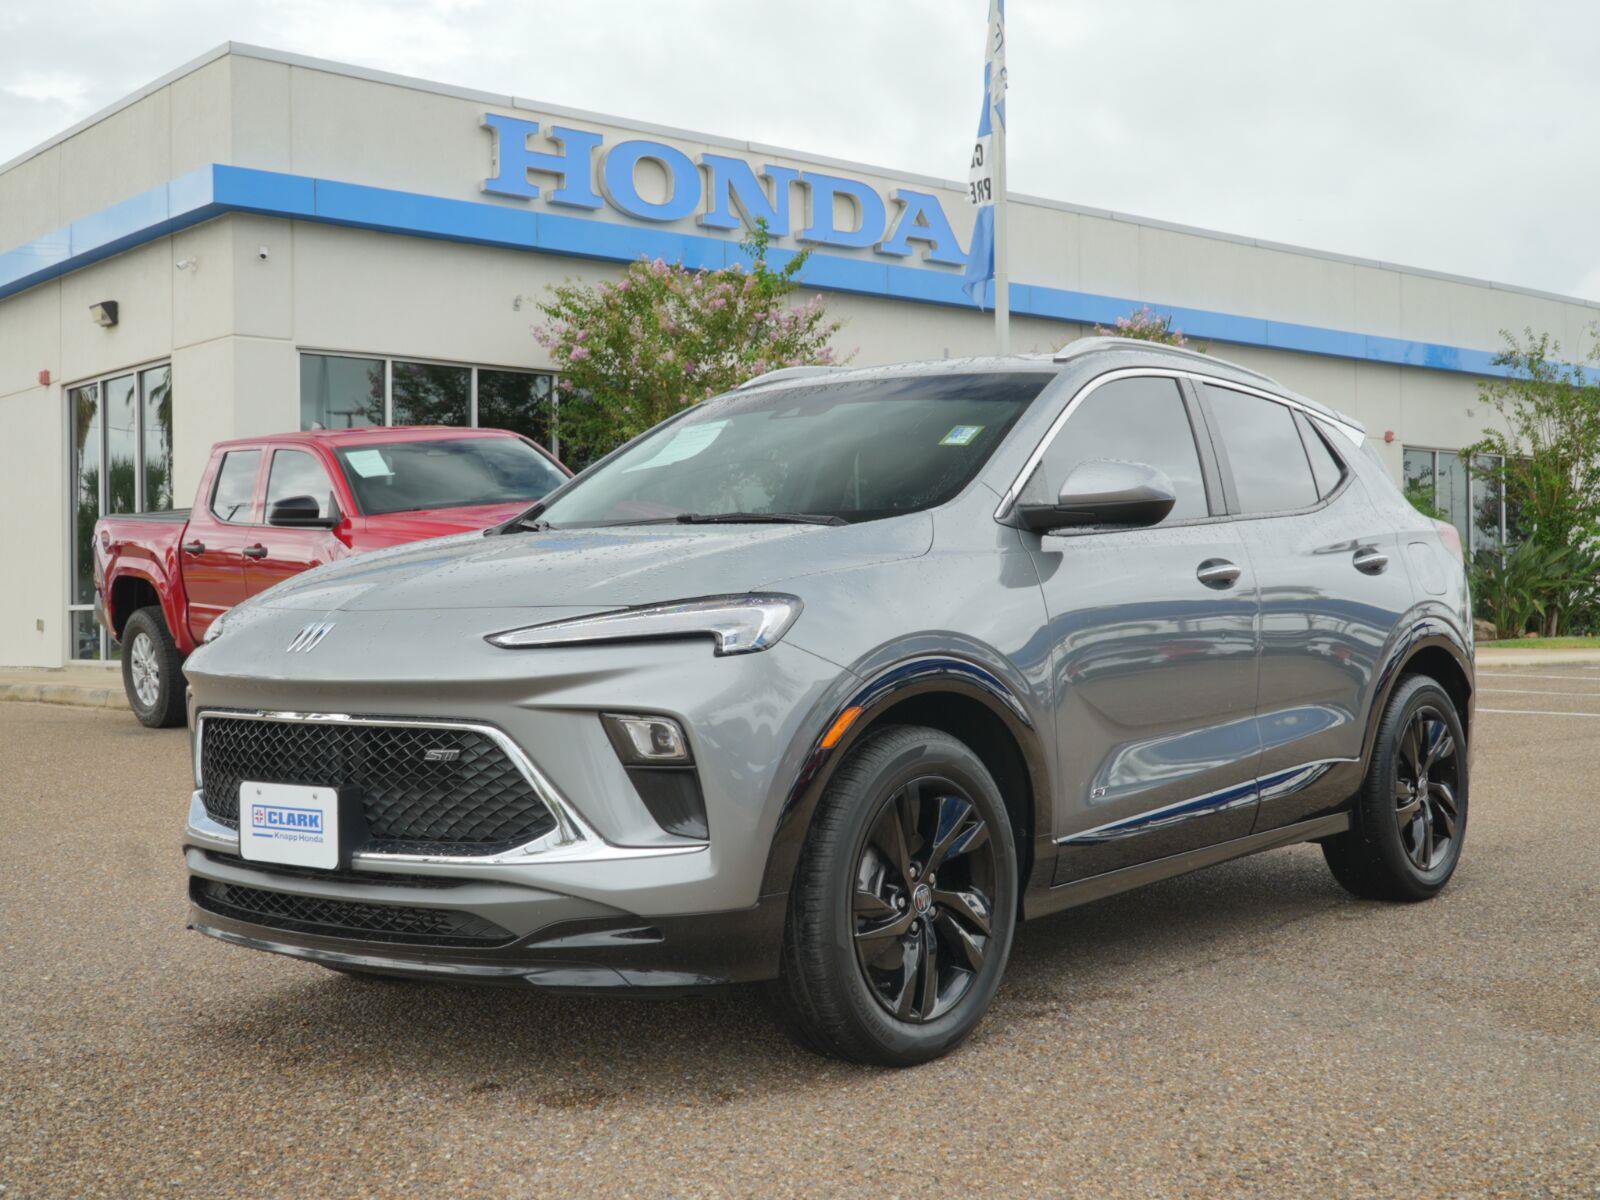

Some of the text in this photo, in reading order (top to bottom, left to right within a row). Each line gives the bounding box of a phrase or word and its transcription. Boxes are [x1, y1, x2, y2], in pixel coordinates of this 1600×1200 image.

[480, 113, 967, 266] HONDA
[268, 811, 320, 828] CLARK
[274, 832, 324, 843] Knapp Honda
